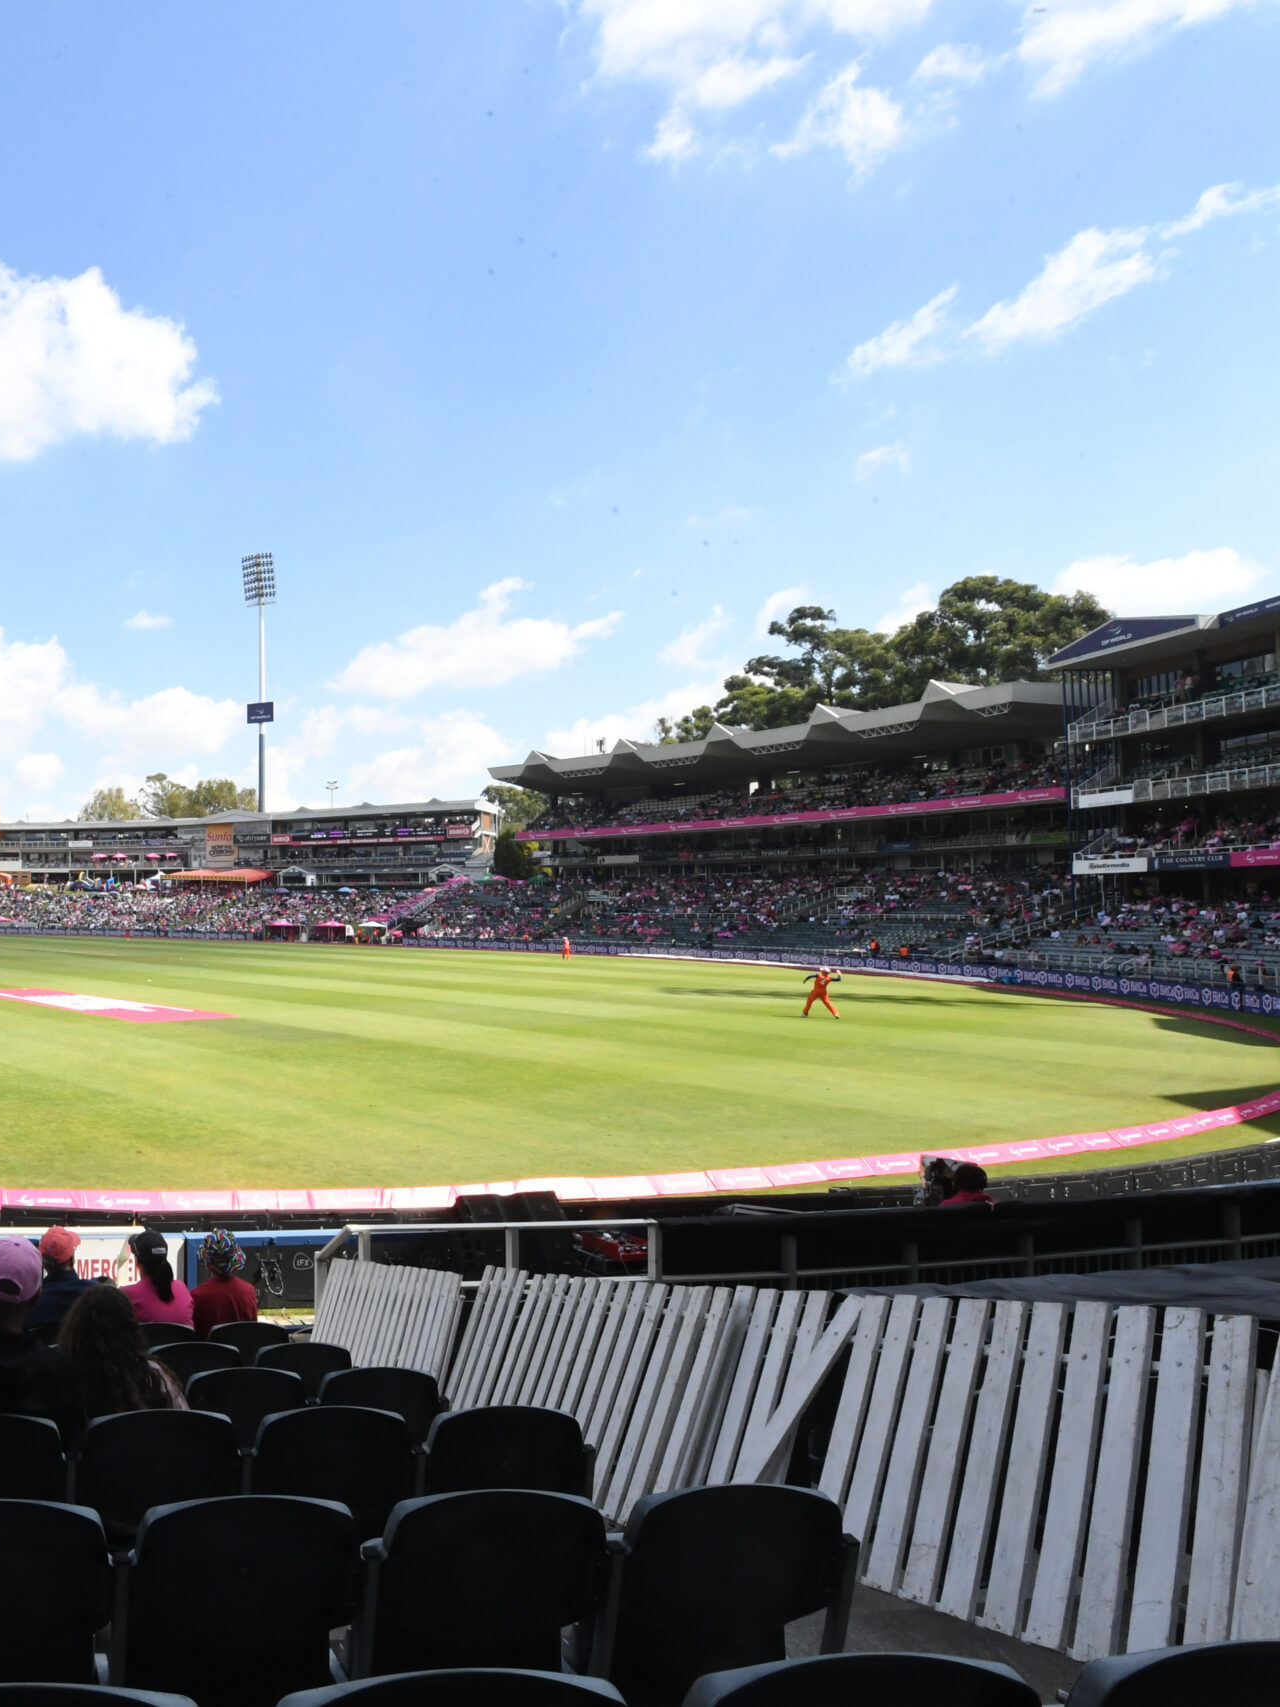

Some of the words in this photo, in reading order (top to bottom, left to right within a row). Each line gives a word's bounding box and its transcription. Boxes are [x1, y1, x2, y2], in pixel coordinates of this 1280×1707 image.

[761, 849, 789, 857] tractor
[820, 846, 849, 854] tractor
[1207, 854, 1223, 862] CLUB
[972, 967, 987, 977] BitCo
[1024, 971, 1038, 981] BitCo
[1048, 974, 1062, 984] BitCo
[1075, 976, 1089, 986] BitCo
[1102, 979, 1117, 990] BitCo
[1131, 981, 1146, 993] BitCo
[1160, 985, 1174, 997] BitCo
[1184, 988, 1199, 1000] BitCo
[1213, 992, 1228, 1004] BitCo
[1244, 996, 1260, 1008] BitCo
[296, 1259, 310, 1267] IFX
